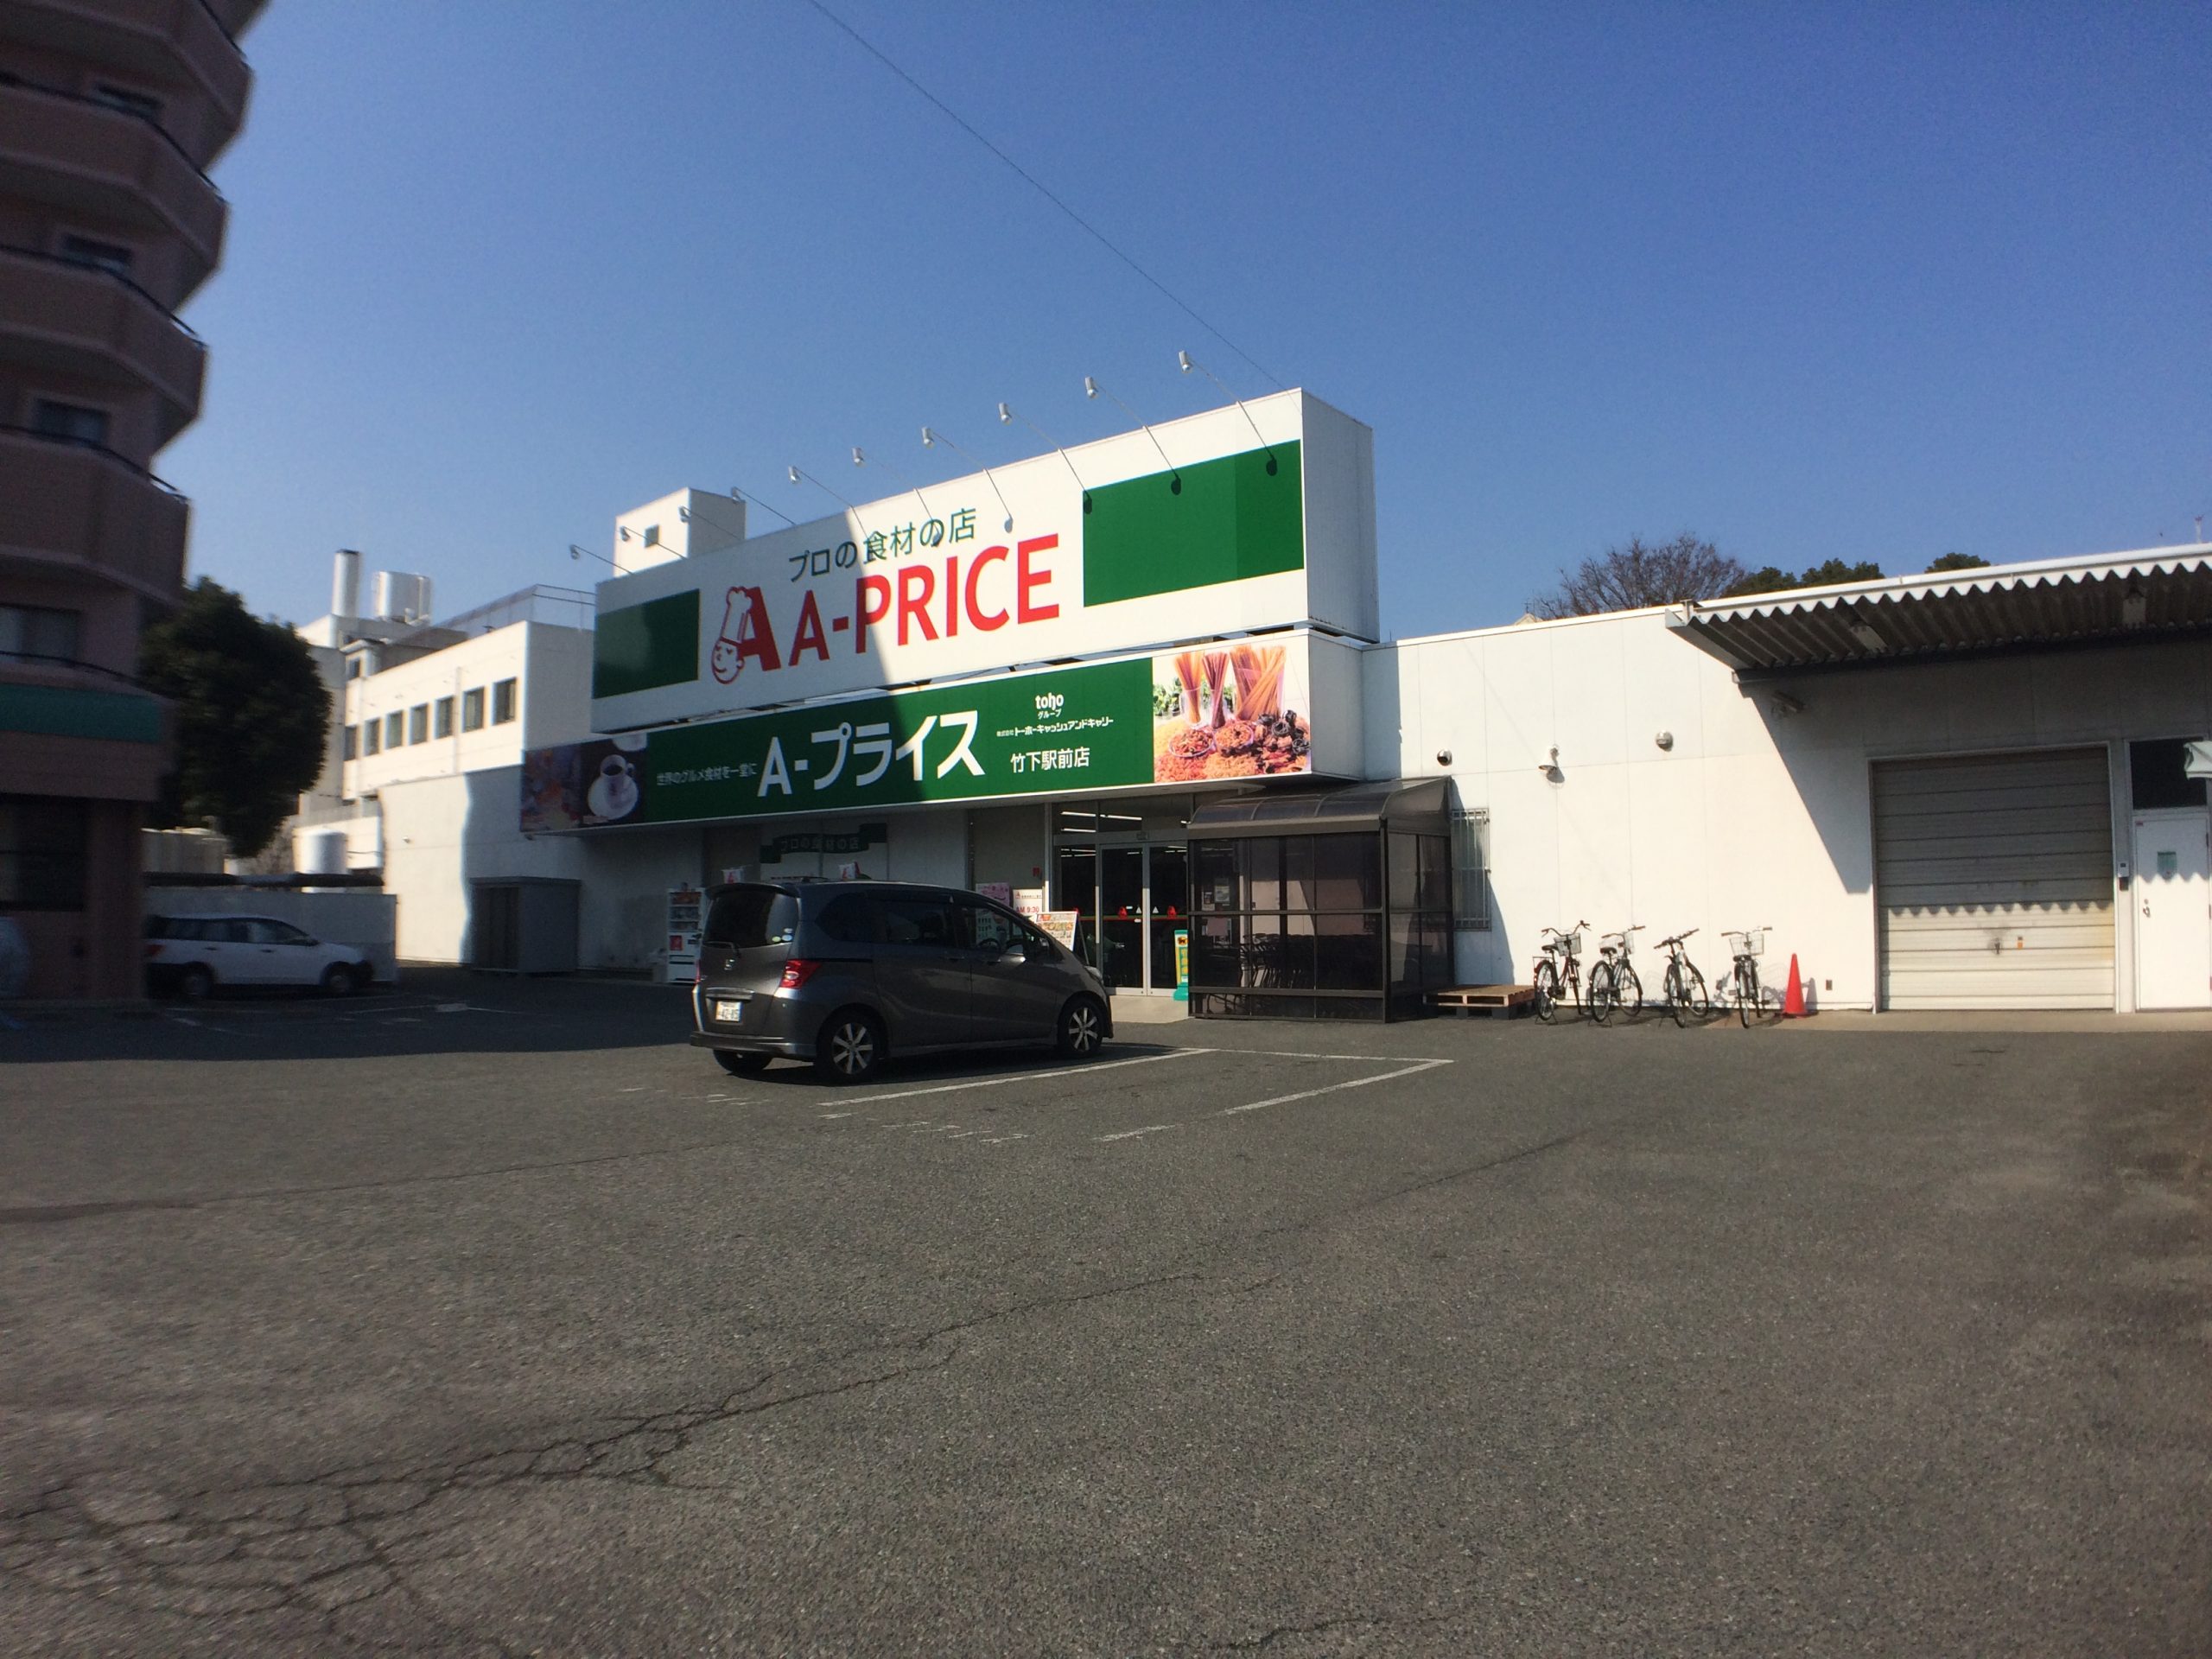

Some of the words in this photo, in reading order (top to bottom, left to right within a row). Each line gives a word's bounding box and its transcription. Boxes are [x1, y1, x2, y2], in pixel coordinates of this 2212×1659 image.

[789, 507, 976, 583] プロの食材の店
[788, 533, 1060, 667] A-PRICE
[1035, 692, 1065, 710] toho
[1038, 709, 1062, 720] グループ
[1010, 746, 1090, 773] 竹下駅前店
